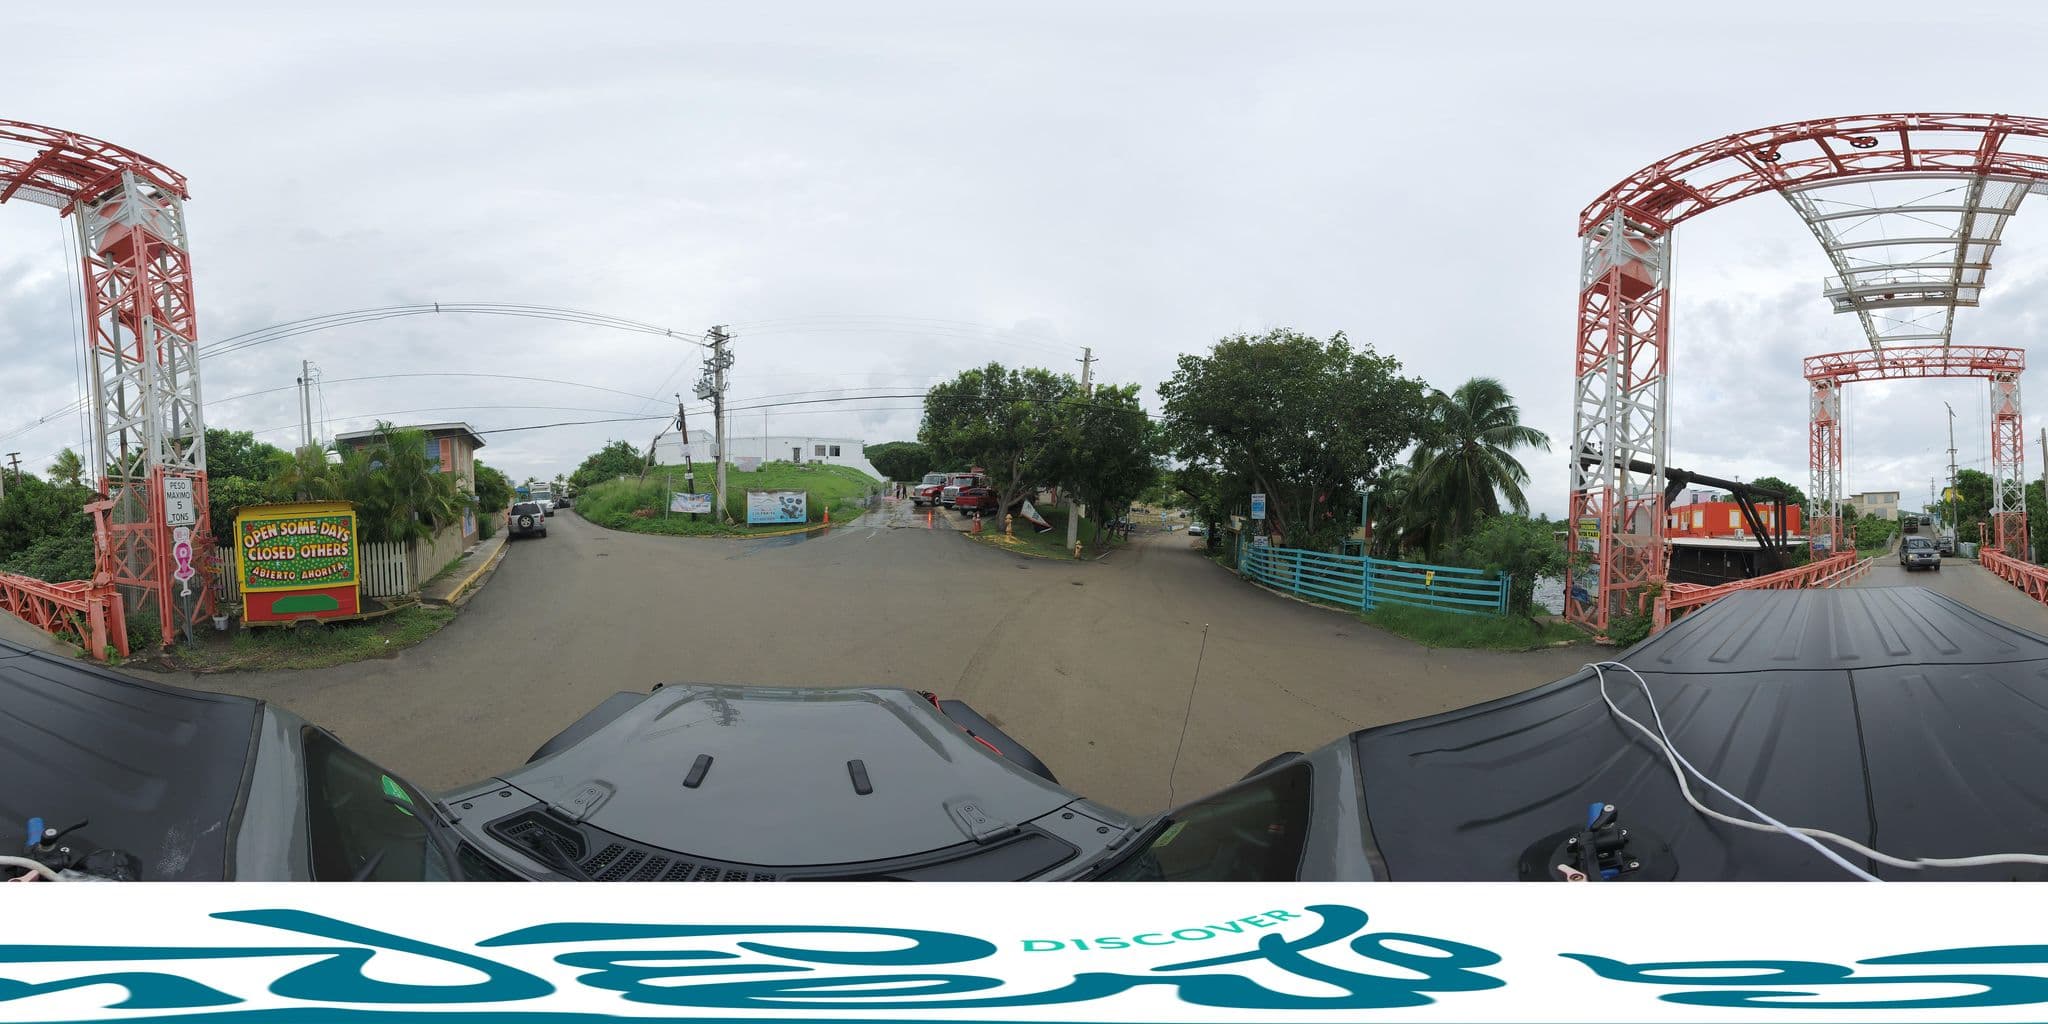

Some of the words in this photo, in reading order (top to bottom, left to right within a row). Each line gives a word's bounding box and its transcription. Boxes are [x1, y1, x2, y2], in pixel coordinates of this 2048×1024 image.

[170, 482, 186, 490] PESO
[167, 491, 191, 499] MAXIMO
[177, 501, 182, 510] 5
[172, 513, 189, 521] TONS
[243, 523, 278, 548] OPEN
[280, 520, 318, 536] SOME
[320, 522, 351, 542] DAYS
[248, 545, 296, 561] CLOSED
[300, 542, 349, 558] OTHERS
[252, 566, 296, 580] ABIERTO
[301, 561, 344, 579] AHORITA
